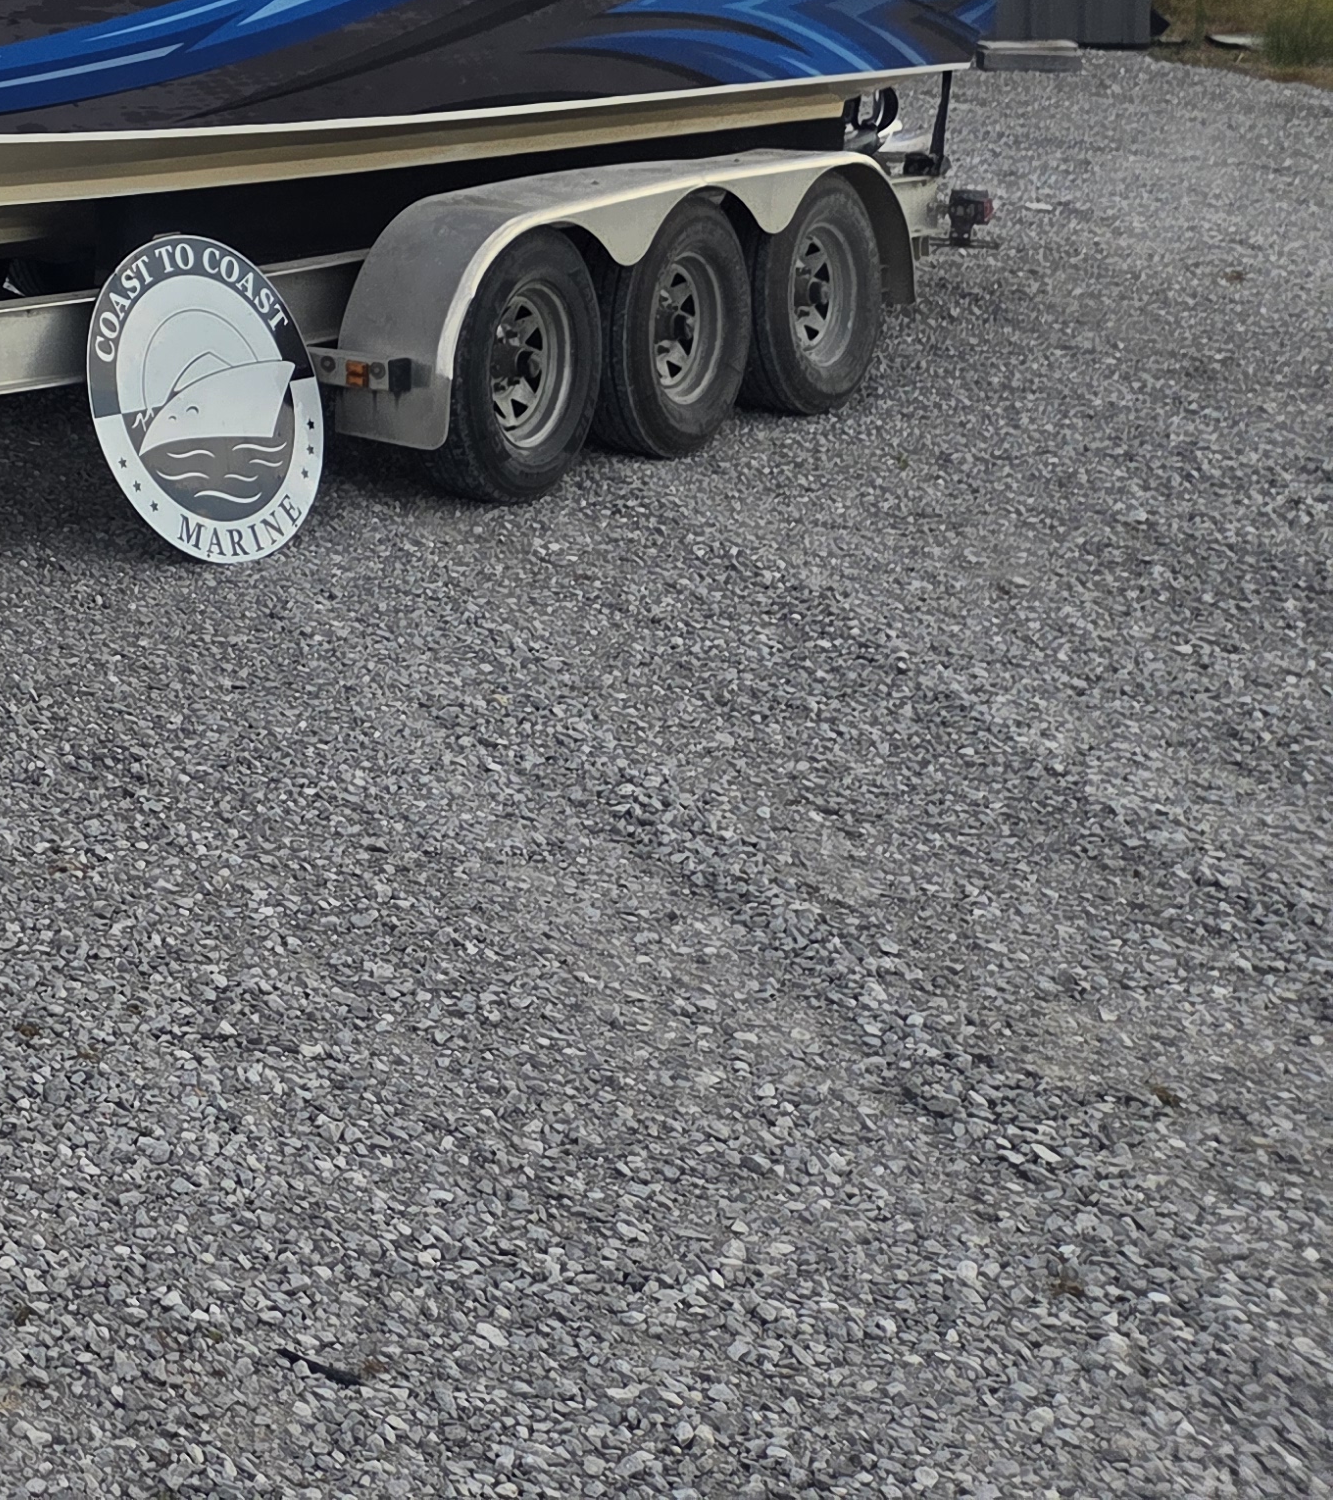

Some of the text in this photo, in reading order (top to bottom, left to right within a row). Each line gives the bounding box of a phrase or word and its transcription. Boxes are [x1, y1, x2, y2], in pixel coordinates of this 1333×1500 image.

[95, 243, 289, 362] COAST TO COAST
[177, 493, 302, 557] MARINE
